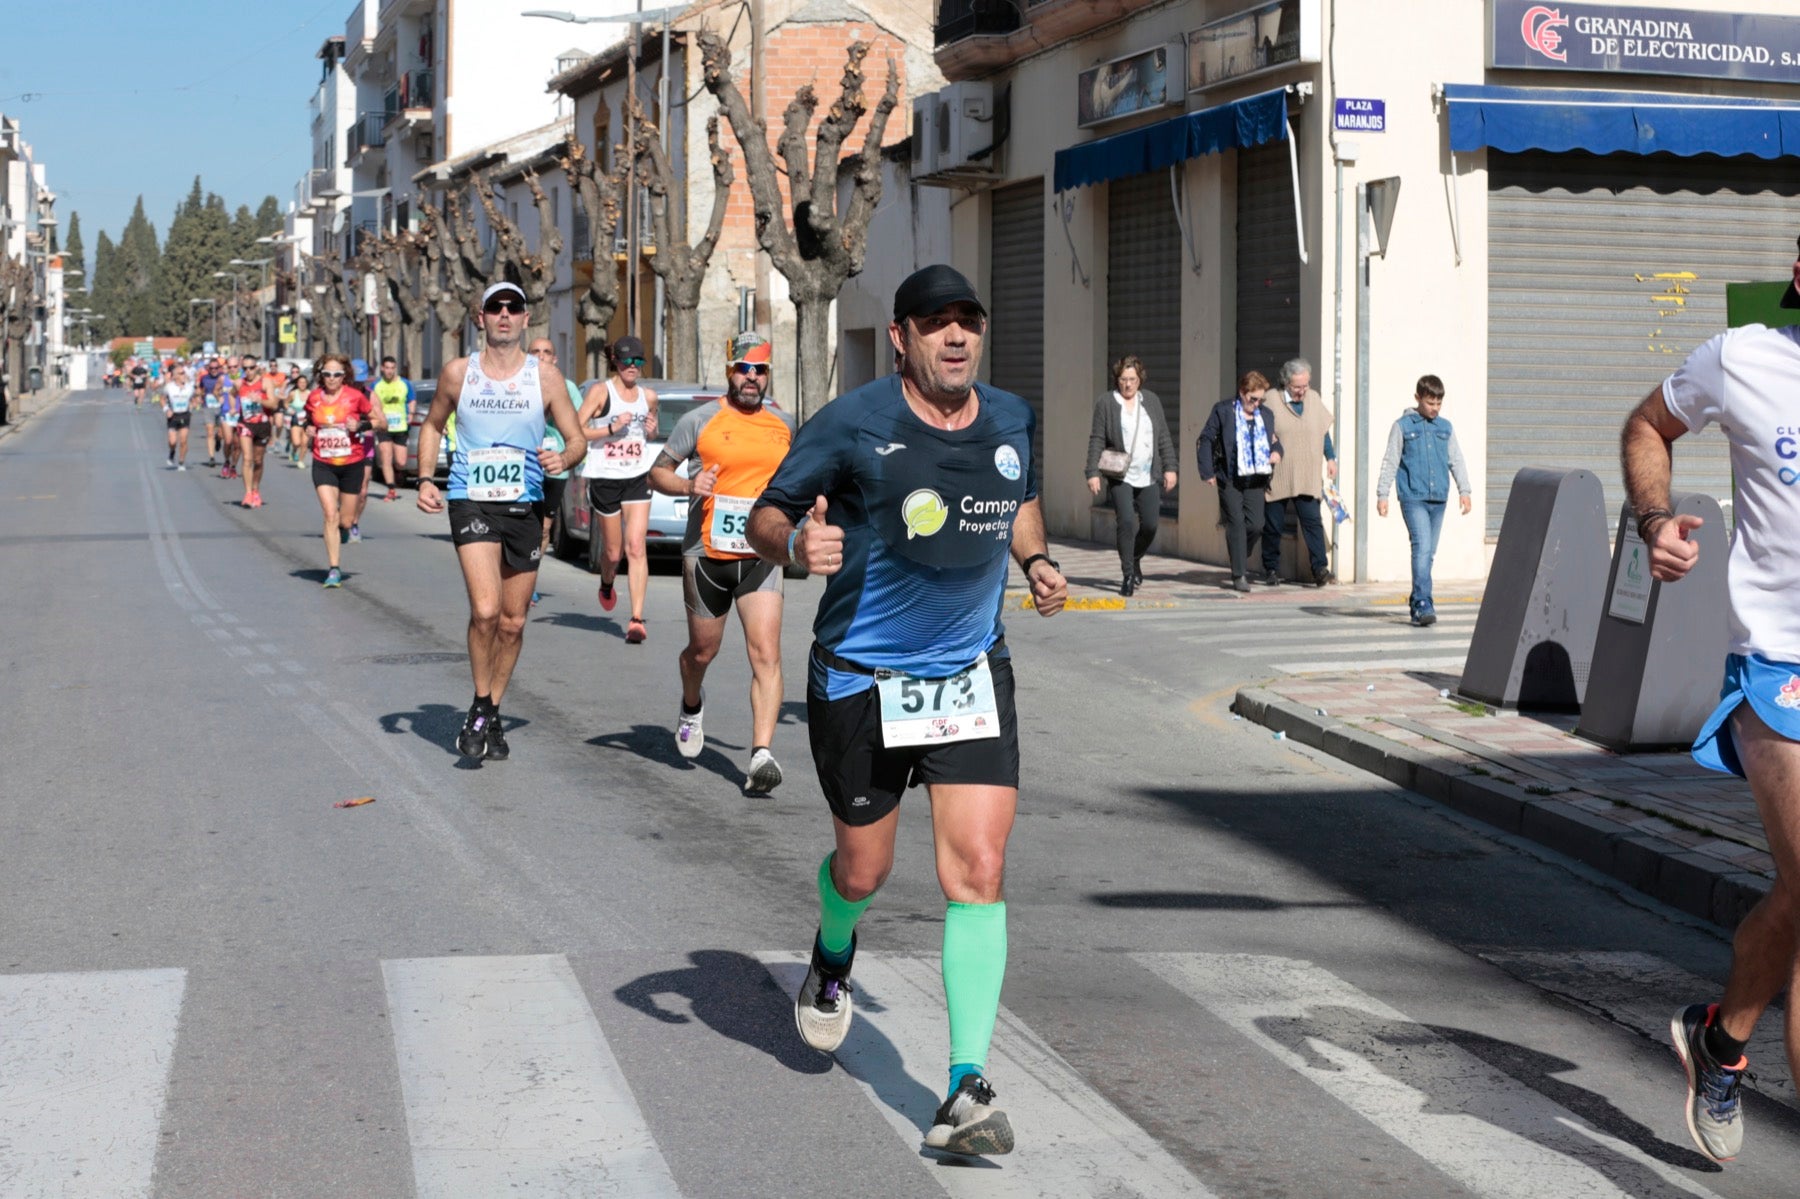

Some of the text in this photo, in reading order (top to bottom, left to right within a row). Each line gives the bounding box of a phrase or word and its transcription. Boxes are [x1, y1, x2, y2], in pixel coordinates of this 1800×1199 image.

[1575, 16, 1693, 39] GRANADINA
[1591, 37, 1619, 55] DE
[1624, 39, 1775, 66] ELECTRICIDAD,
[1345, 100, 1373, 111] PLAZA
[1337, 114, 1383, 129] NARANJOS
[470, 399, 530, 409] MARACENA
[607, 442, 641, 456] 2143
[473, 464, 521, 484] 1042
[961, 495, 1017, 517] Campo
[959, 519, 1009, 534] Proyectos
[996, 530, 1007, 540] .es
[901, 673, 975, 713] 573
